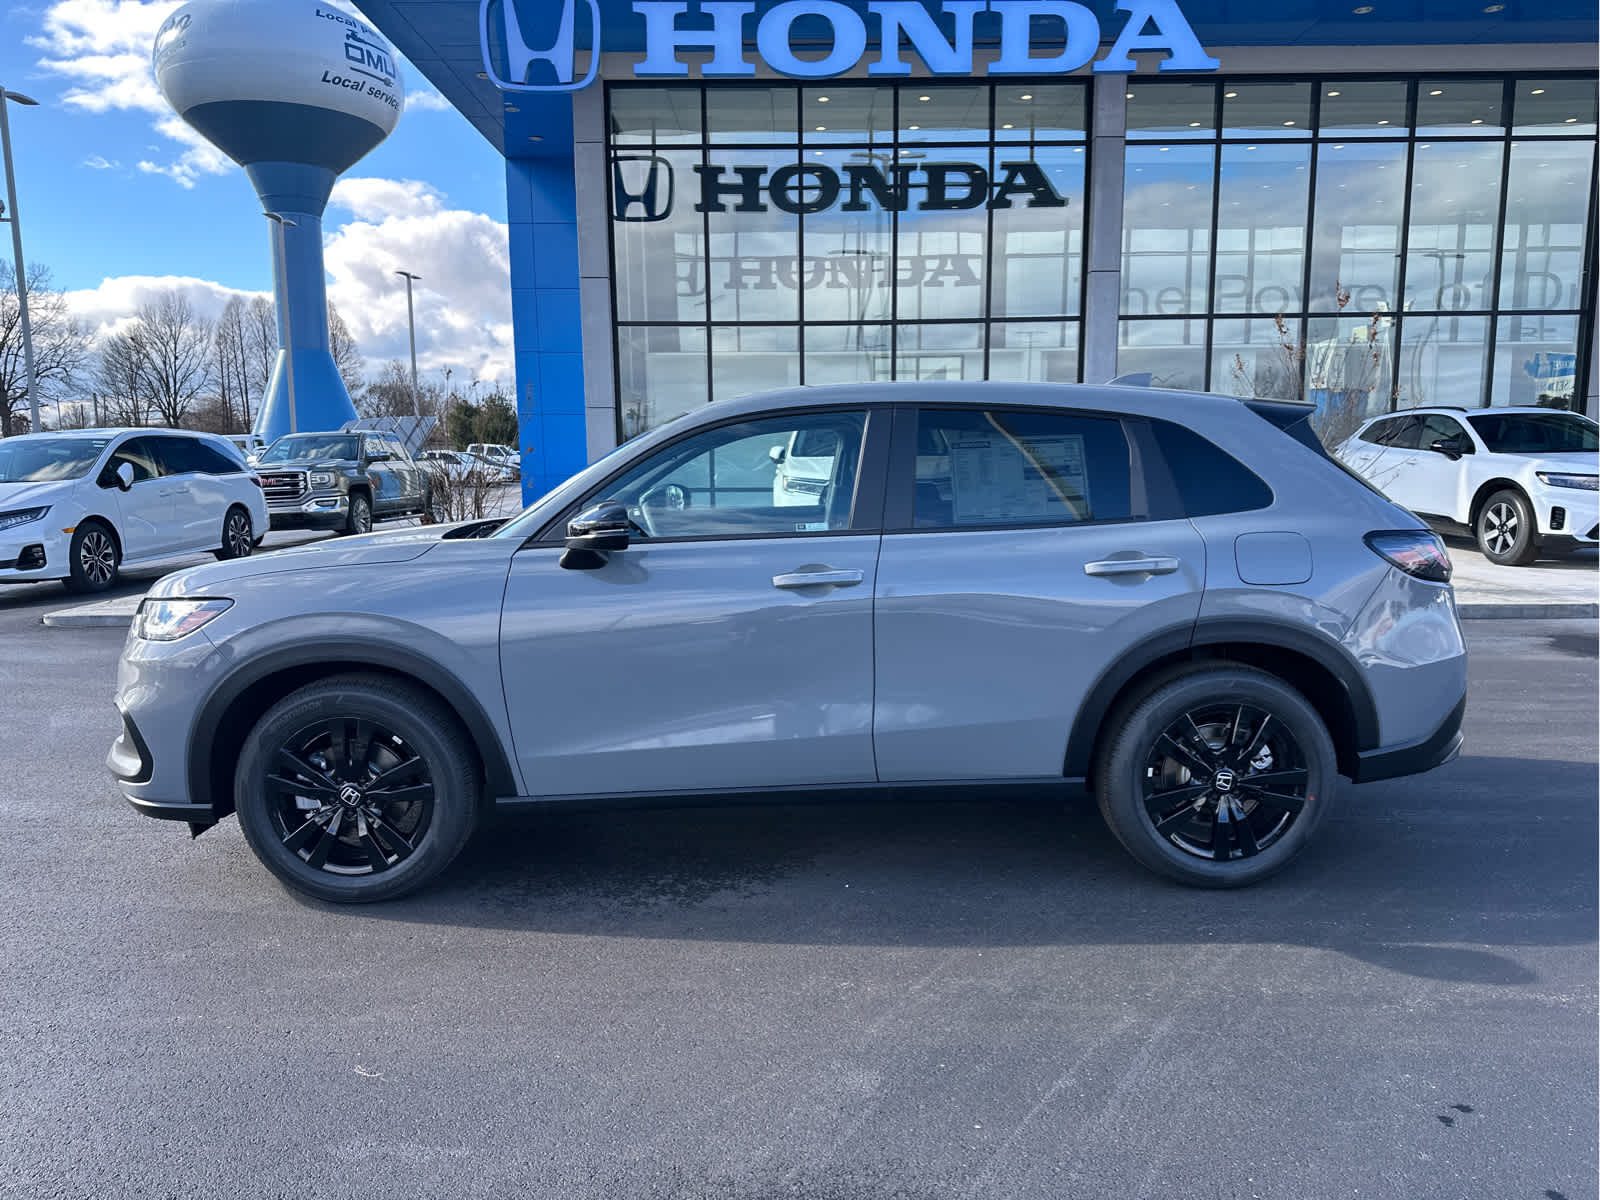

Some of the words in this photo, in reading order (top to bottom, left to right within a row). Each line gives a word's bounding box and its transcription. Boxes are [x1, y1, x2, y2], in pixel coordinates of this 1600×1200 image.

[315, 8, 357, 29] Local
[632, 0, 1221, 78] HONDA
[321, 70, 366, 92] Local
[693, 161, 1069, 214] HONDA
